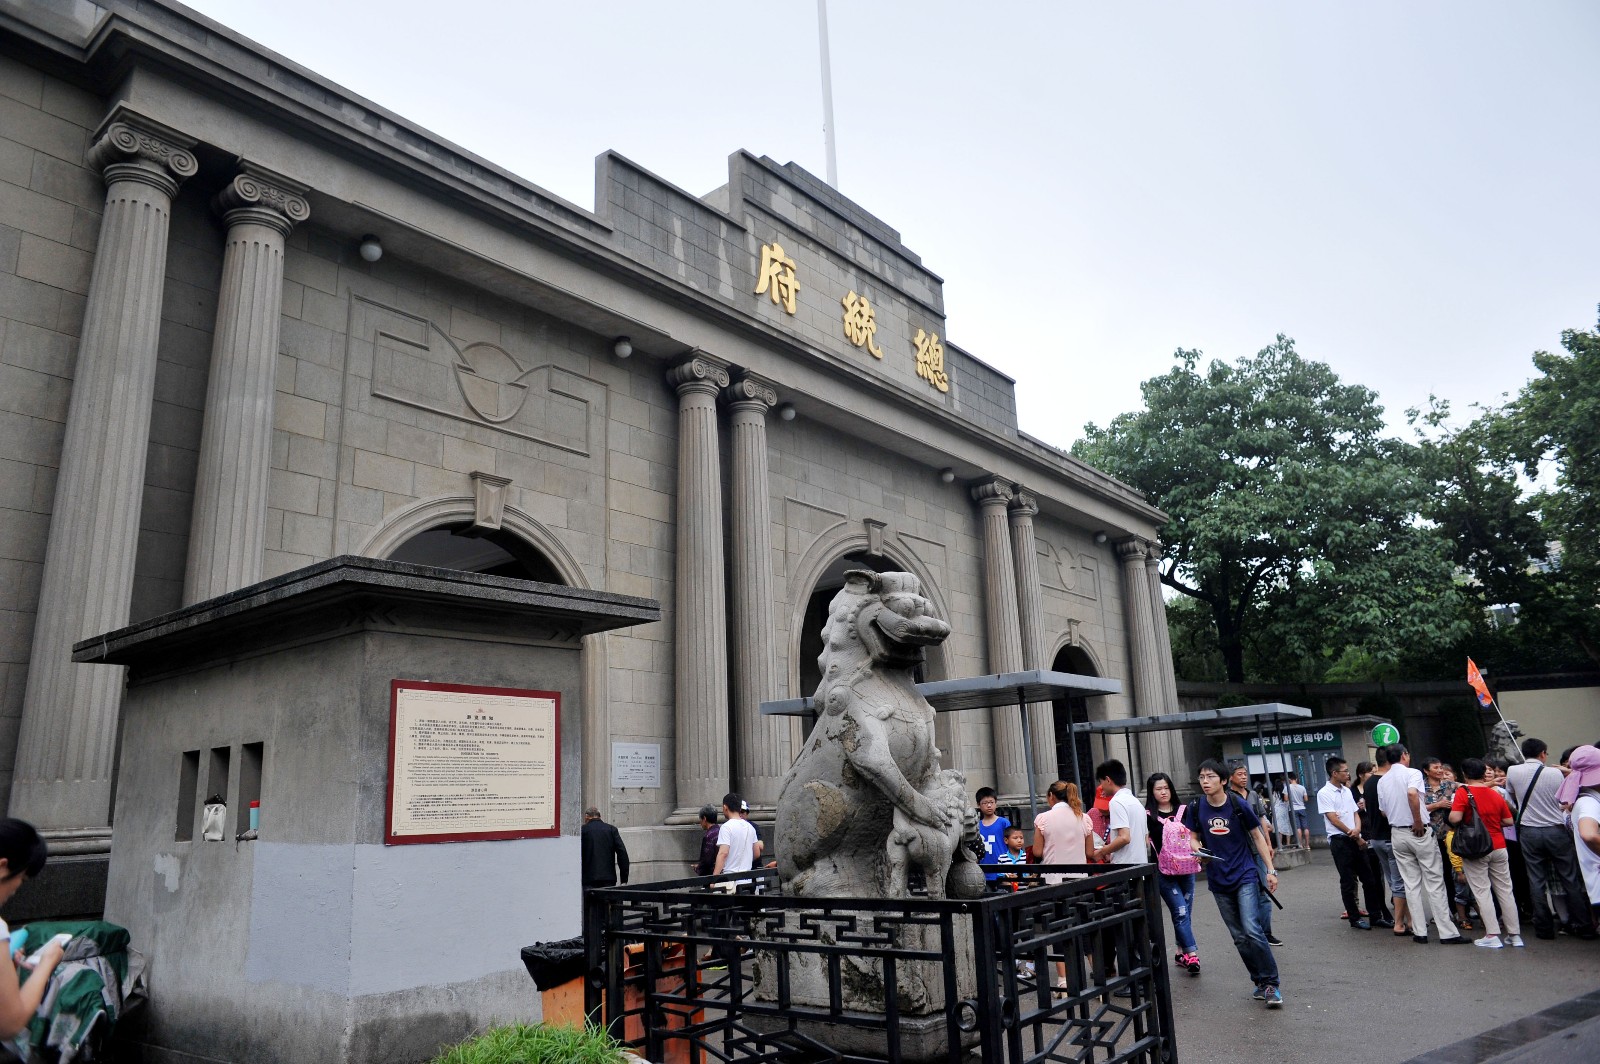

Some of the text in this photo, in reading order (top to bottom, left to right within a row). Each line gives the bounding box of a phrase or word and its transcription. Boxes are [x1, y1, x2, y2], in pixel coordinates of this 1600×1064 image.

[1251, 731, 1334, 747] 南京旅游咨询中心
